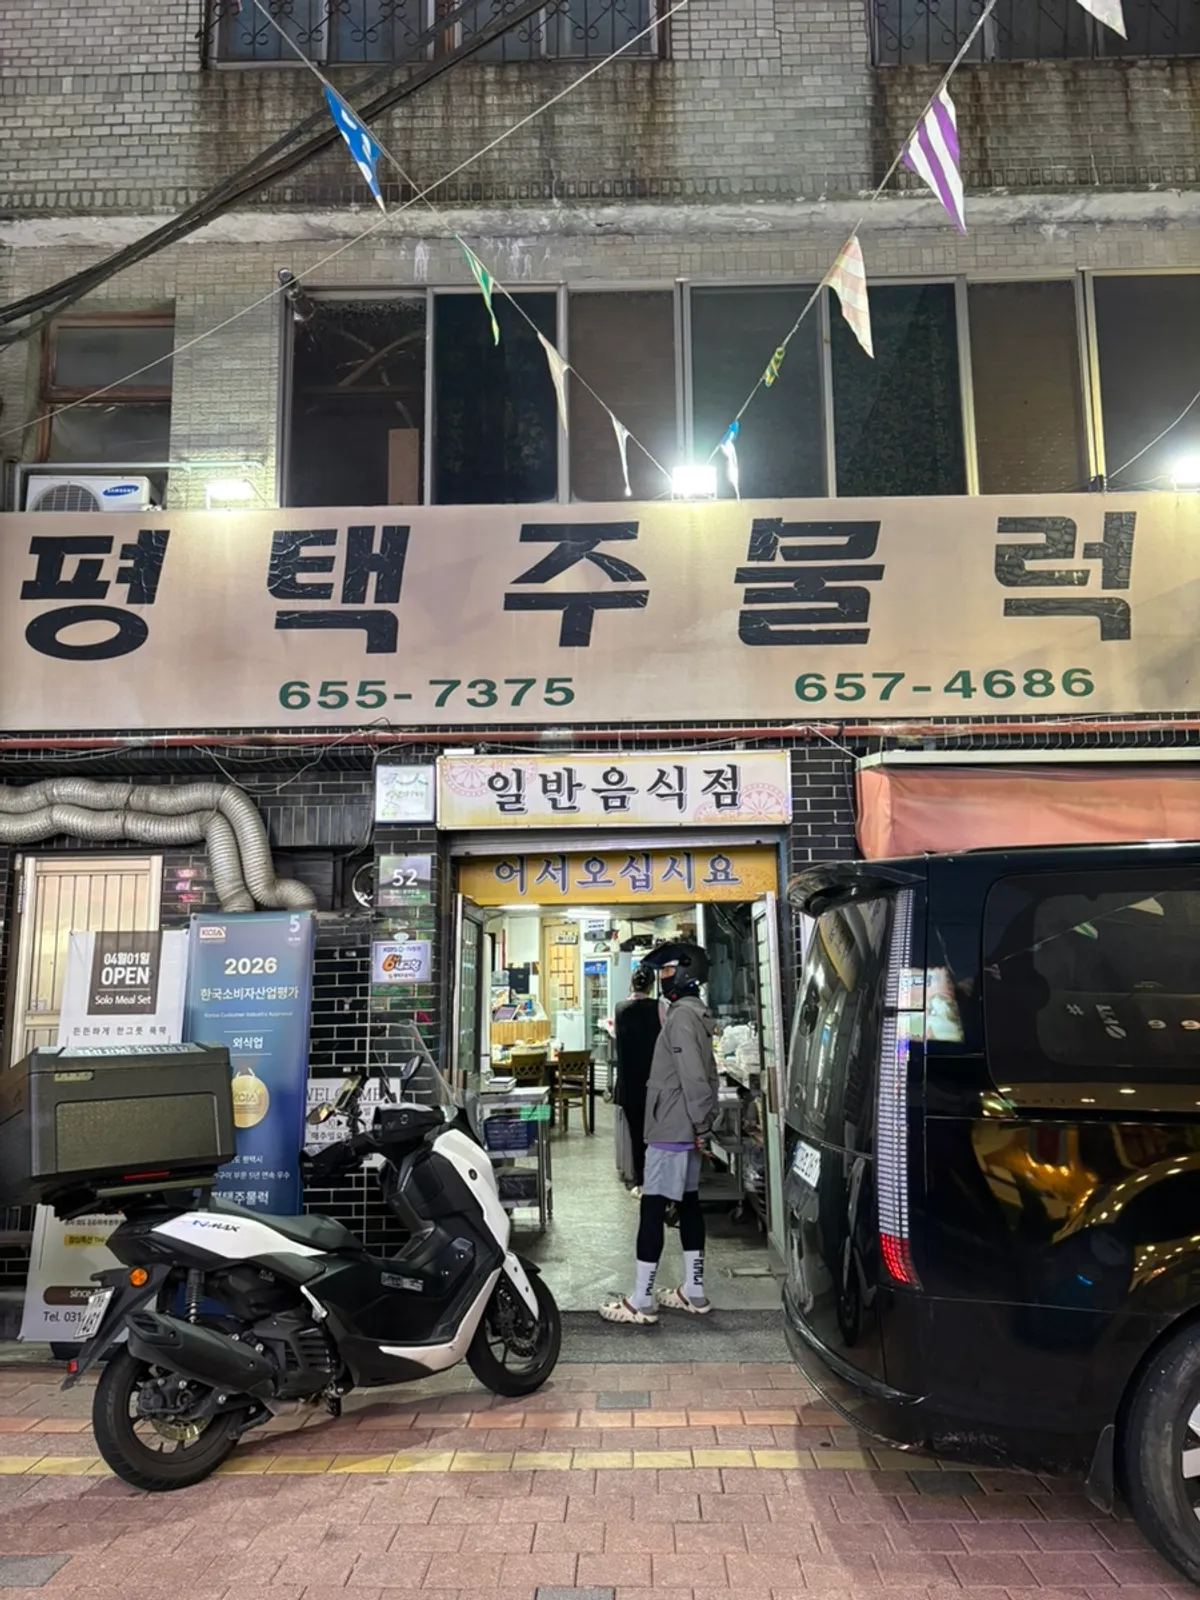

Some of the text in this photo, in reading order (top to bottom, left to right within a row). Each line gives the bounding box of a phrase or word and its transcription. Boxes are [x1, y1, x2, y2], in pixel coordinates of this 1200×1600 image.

[20, 511, 1137, 661] 평택주물럭
[279, 677, 576, 710] 655-7375
[794, 668, 1095, 702] 657-4686
[486, 764, 742, 813] 일반음식점
[391, 868, 418, 887] 52
[494, 851, 741, 895] 어서오십시요
[289, 915, 300, 933] 5
[104, 952, 151, 966] 04월01일
[224, 957, 277, 975] 2026
[101, 966, 150, 985] OPEN
[95, 994, 151, 1005] Solo Meal Set
[200, 986, 299, 1001] 한국소비자산업평가
[232, 1036, 264, 1049] 외식업
[70, 1288, 91, 1299] since
[43, 1311, 81, 1323] Tel. 031
